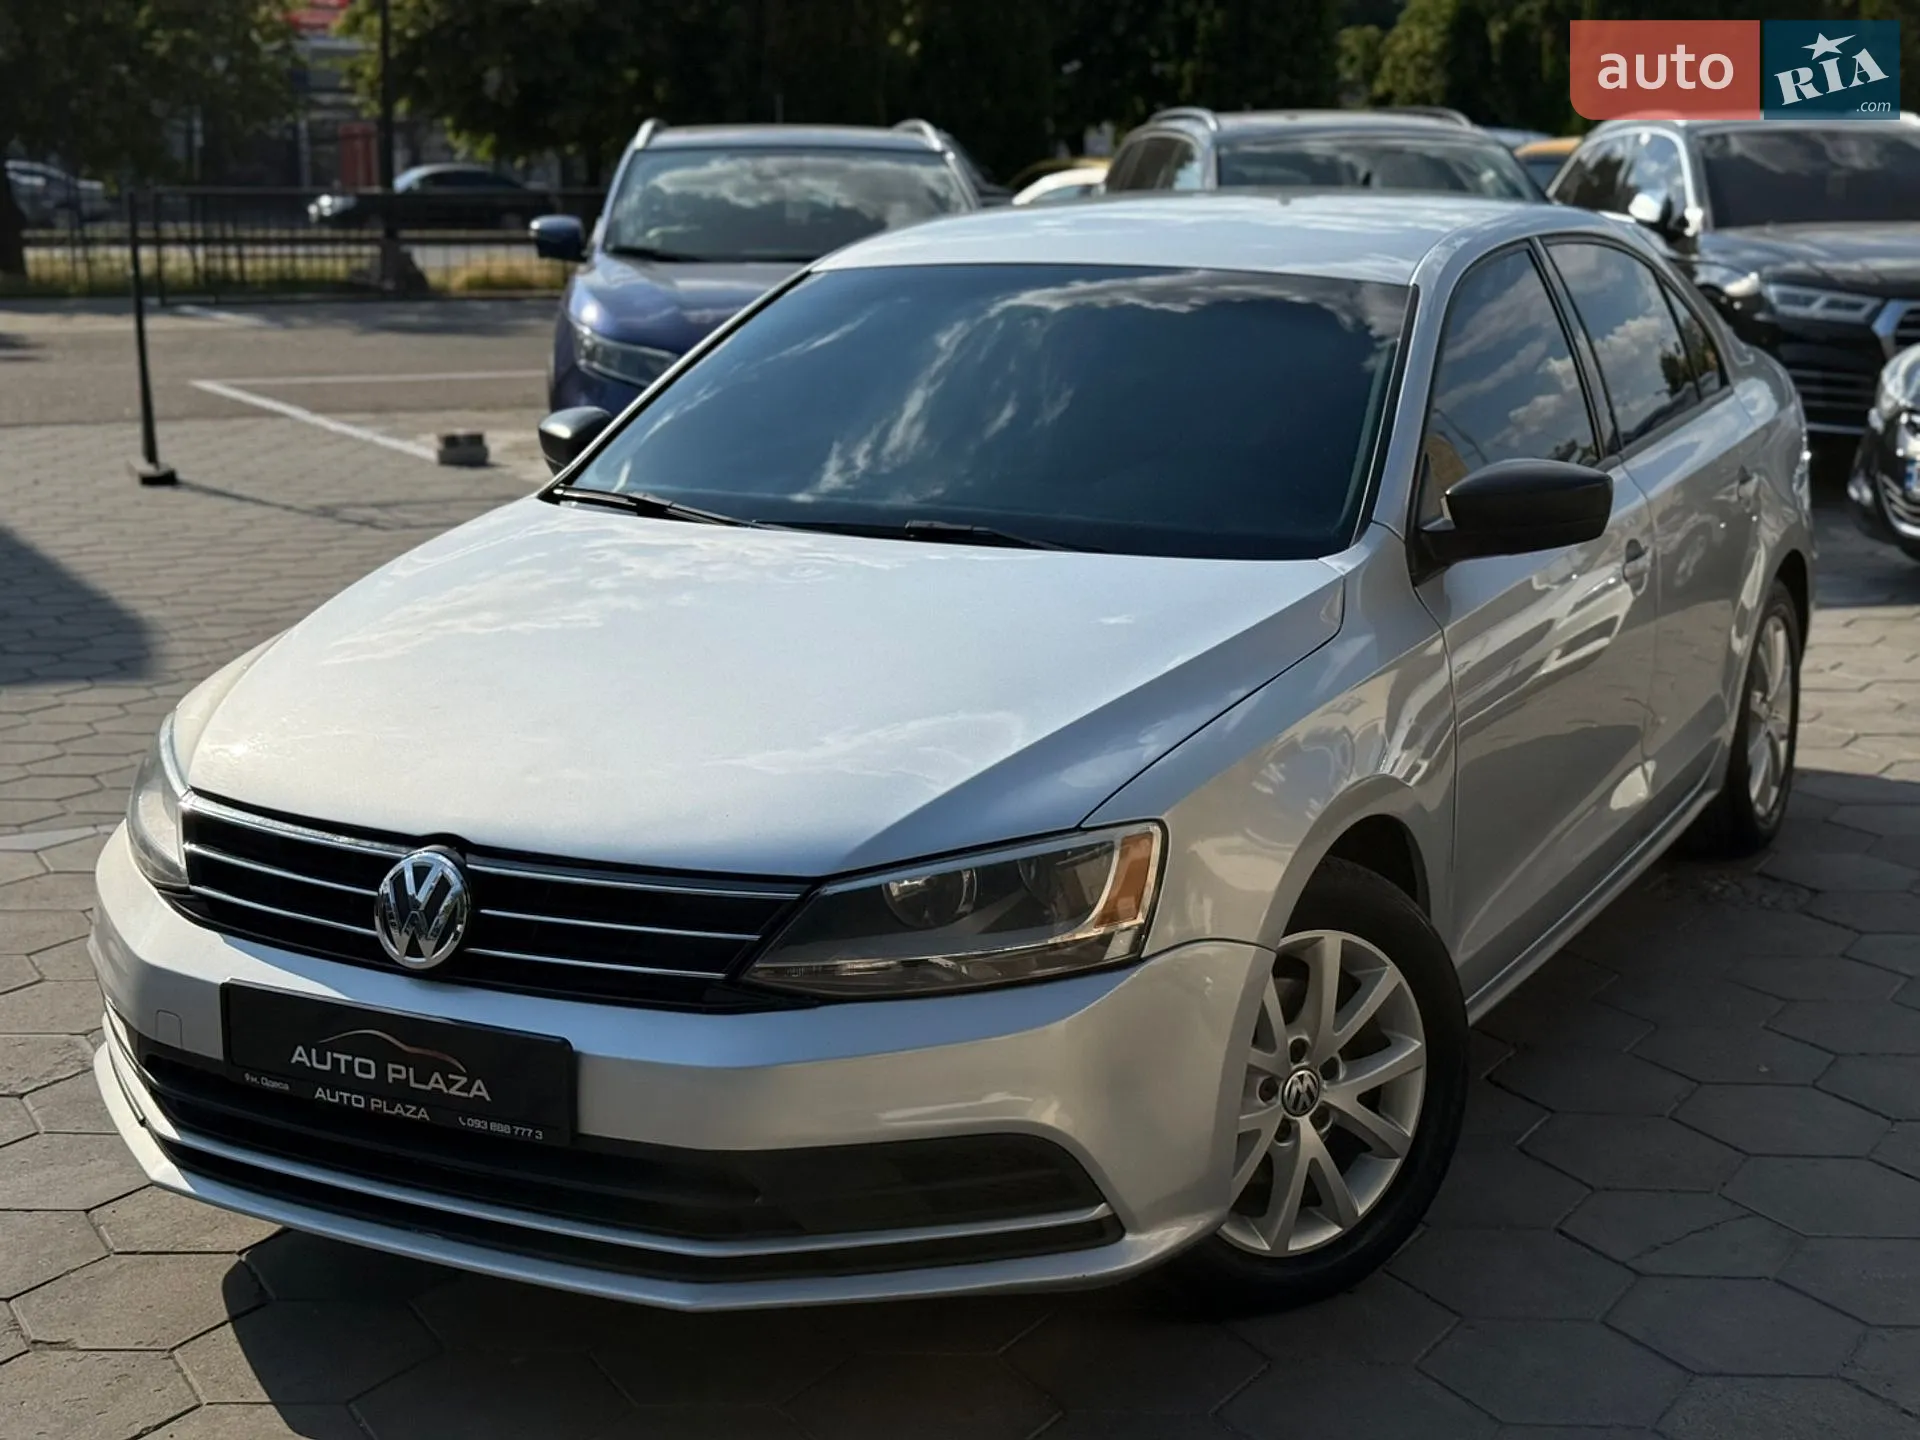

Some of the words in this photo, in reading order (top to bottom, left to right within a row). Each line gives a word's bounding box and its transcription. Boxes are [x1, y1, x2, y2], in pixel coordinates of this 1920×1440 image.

[290, 1045, 376, 1080] AUTO
[387, 1062, 492, 1102] PLAZA
[314, 1087, 365, 1109] AUTO
[371, 1097, 431, 1121] PLAZA
[467, 1117, 488, 1130] 093
[512, 1125, 533, 1138] 777
[534, 1130, 543, 1140] 3
